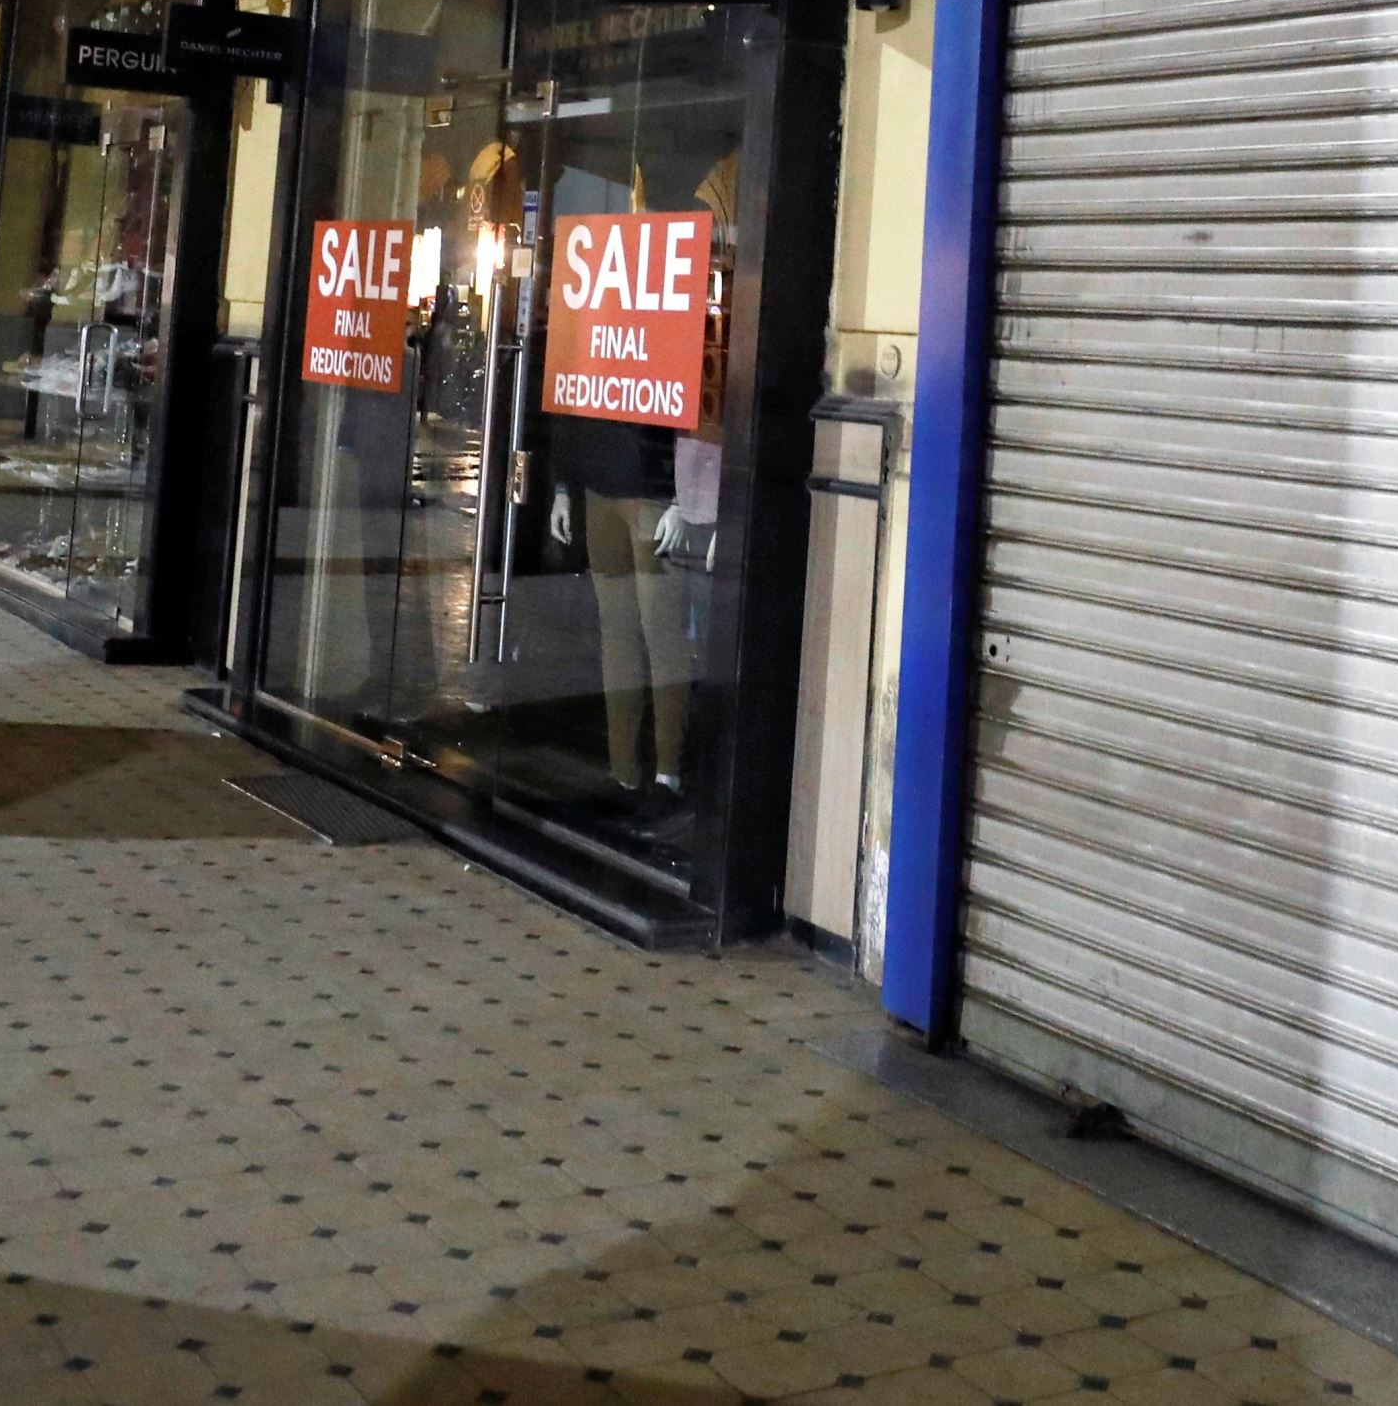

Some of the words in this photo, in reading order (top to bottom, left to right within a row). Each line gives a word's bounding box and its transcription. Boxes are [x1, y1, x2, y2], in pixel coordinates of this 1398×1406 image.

[226, 46, 283, 61] HECHTER
[317, 227, 403, 301] SALE
[562, 221, 695, 312] SALE
[334, 309, 371, 339] FINAL
[590, 324, 649, 361] FINAL
[309, 346, 392, 384] REDUCTIONS
[554, 373, 684, 417] REDUCTIONS
